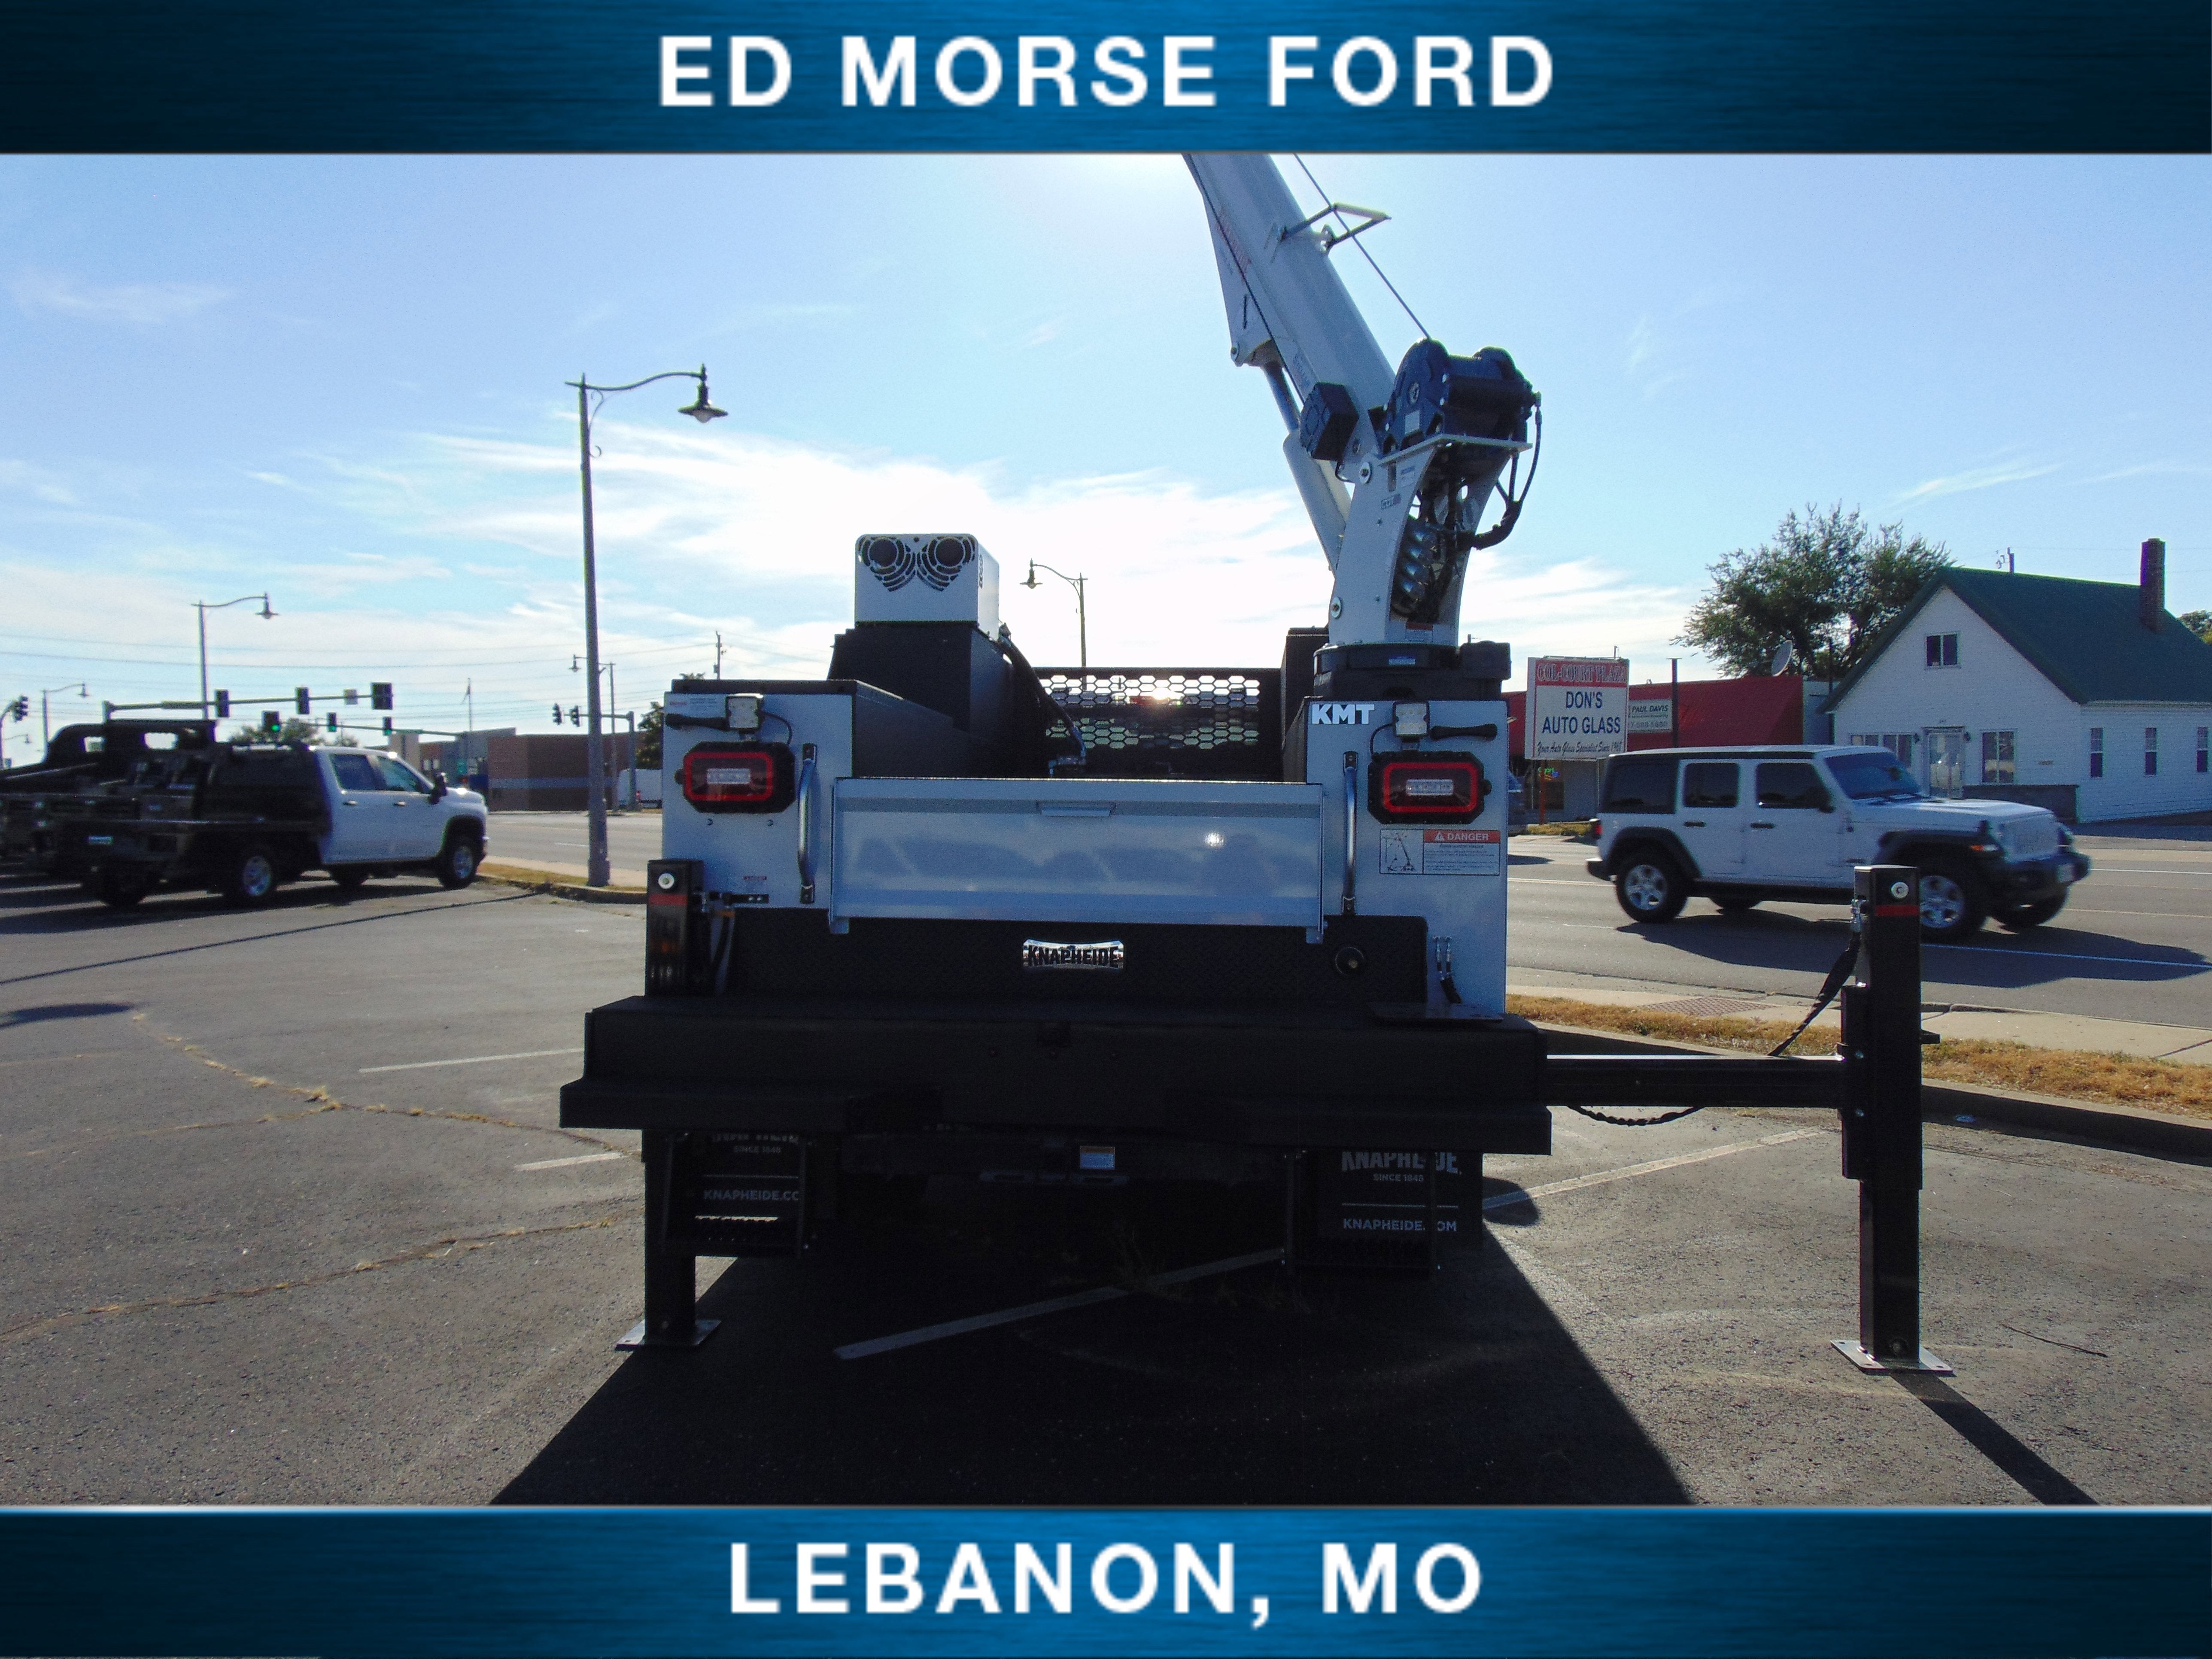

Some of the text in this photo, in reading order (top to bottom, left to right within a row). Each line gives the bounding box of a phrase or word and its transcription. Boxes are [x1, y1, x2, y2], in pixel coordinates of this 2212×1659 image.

[1596, 665, 1626, 683] PLAZA
[1566, 691, 1602, 708] DON'S
[1312, 704, 1375, 725] KMT
[1542, 716, 1621, 734] AUTO GLASS
[1028, 944, 1119, 969] KNAPHEIDE
[703, 1189, 799, 1201] KNAPHEIDE.CO
[1343, 1218, 1457, 1232] KNAPHEIDE.OM
